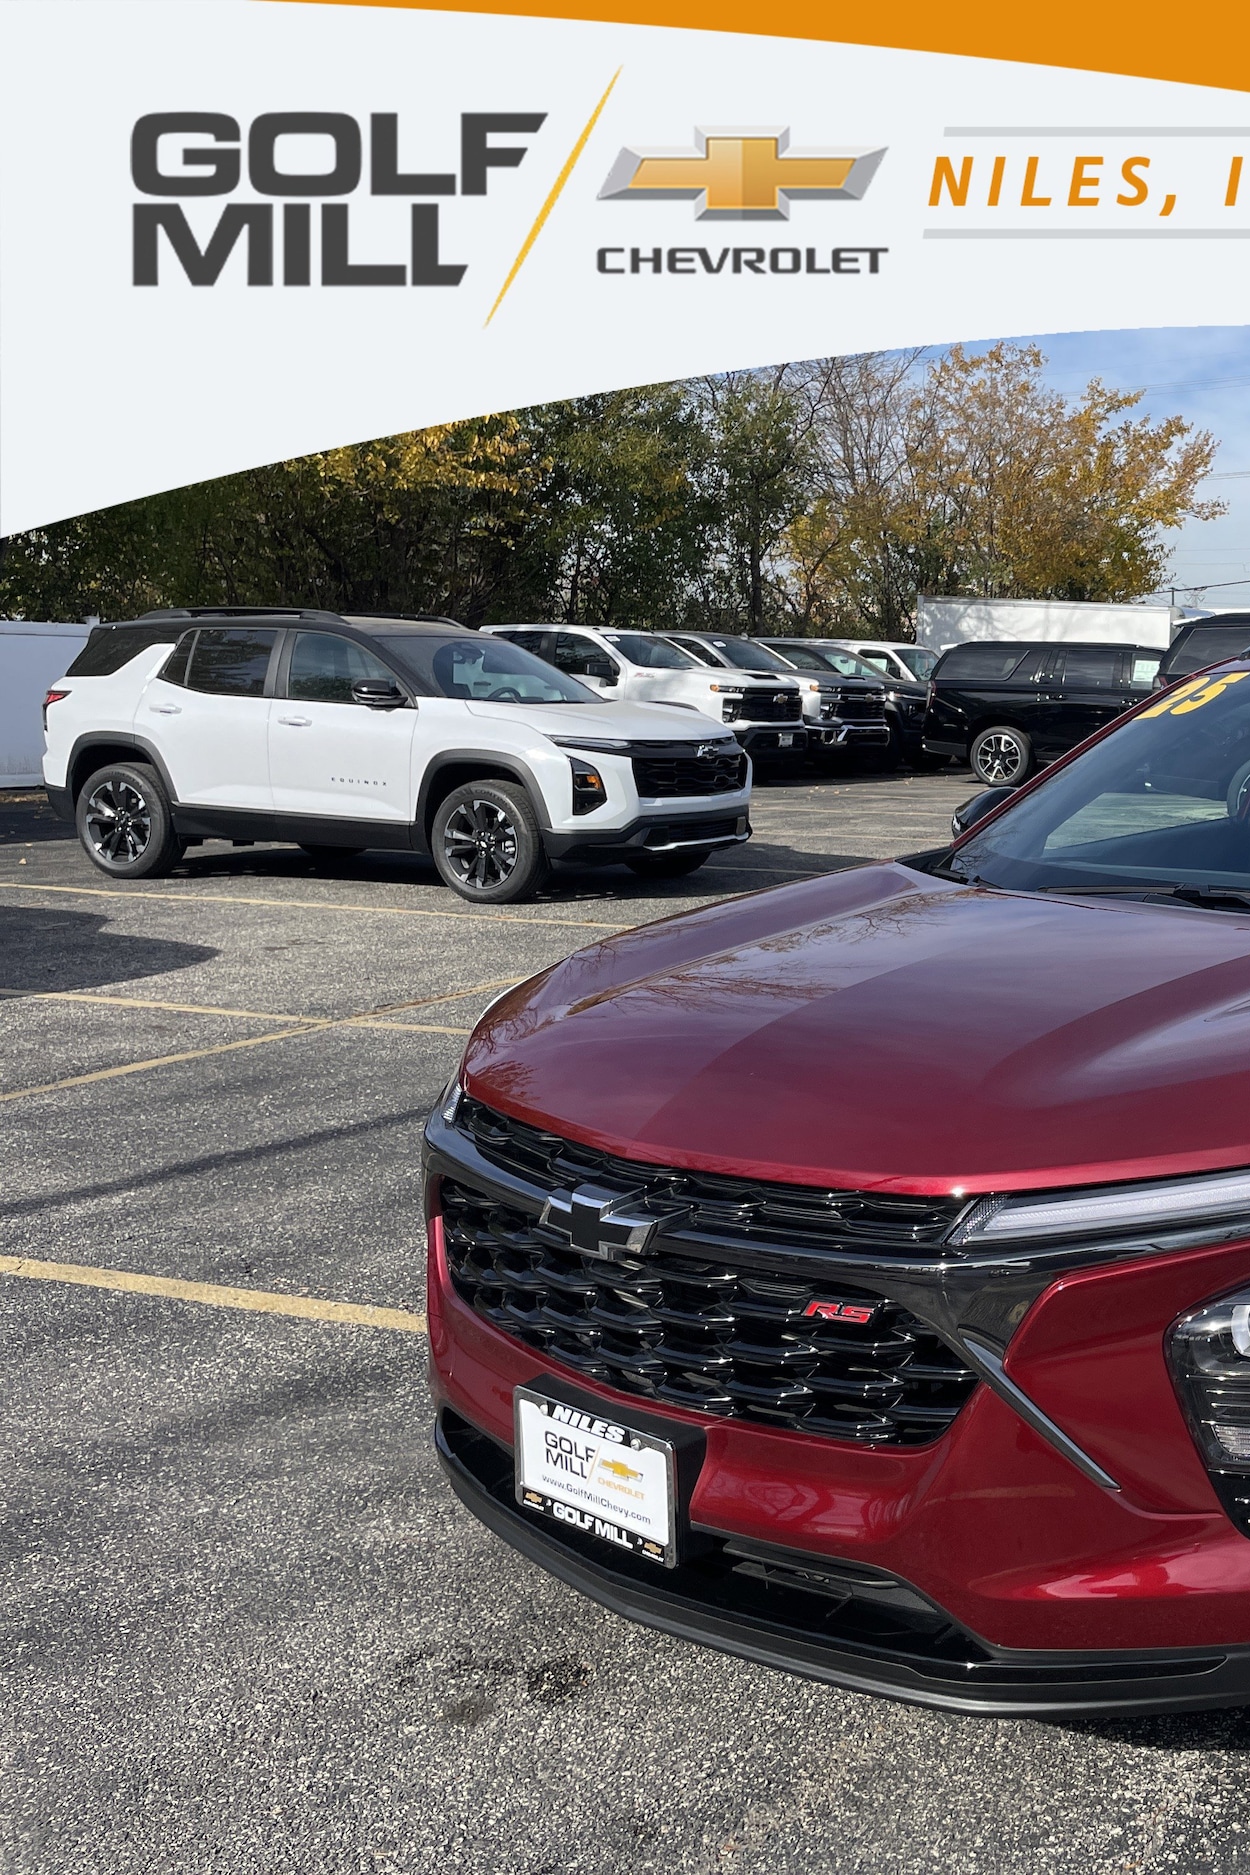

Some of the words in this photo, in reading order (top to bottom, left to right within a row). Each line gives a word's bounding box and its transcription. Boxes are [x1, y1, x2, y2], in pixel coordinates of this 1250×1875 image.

[331, 777, 387, 786] EQUINOX
[801, 1300, 875, 1324] RS
[552, 1404, 626, 1444] NILES
[544, 1431, 596, 1464] GOLF
[545, 1447, 588, 1480] MILL
[541, 1475, 651, 1525] www.GolfMillChevy.com
[597, 1477, 646, 1500] CHEVROLET
[552, 1501, 596, 1532] GOLF
[594, 1518, 634, 1550] MILL
